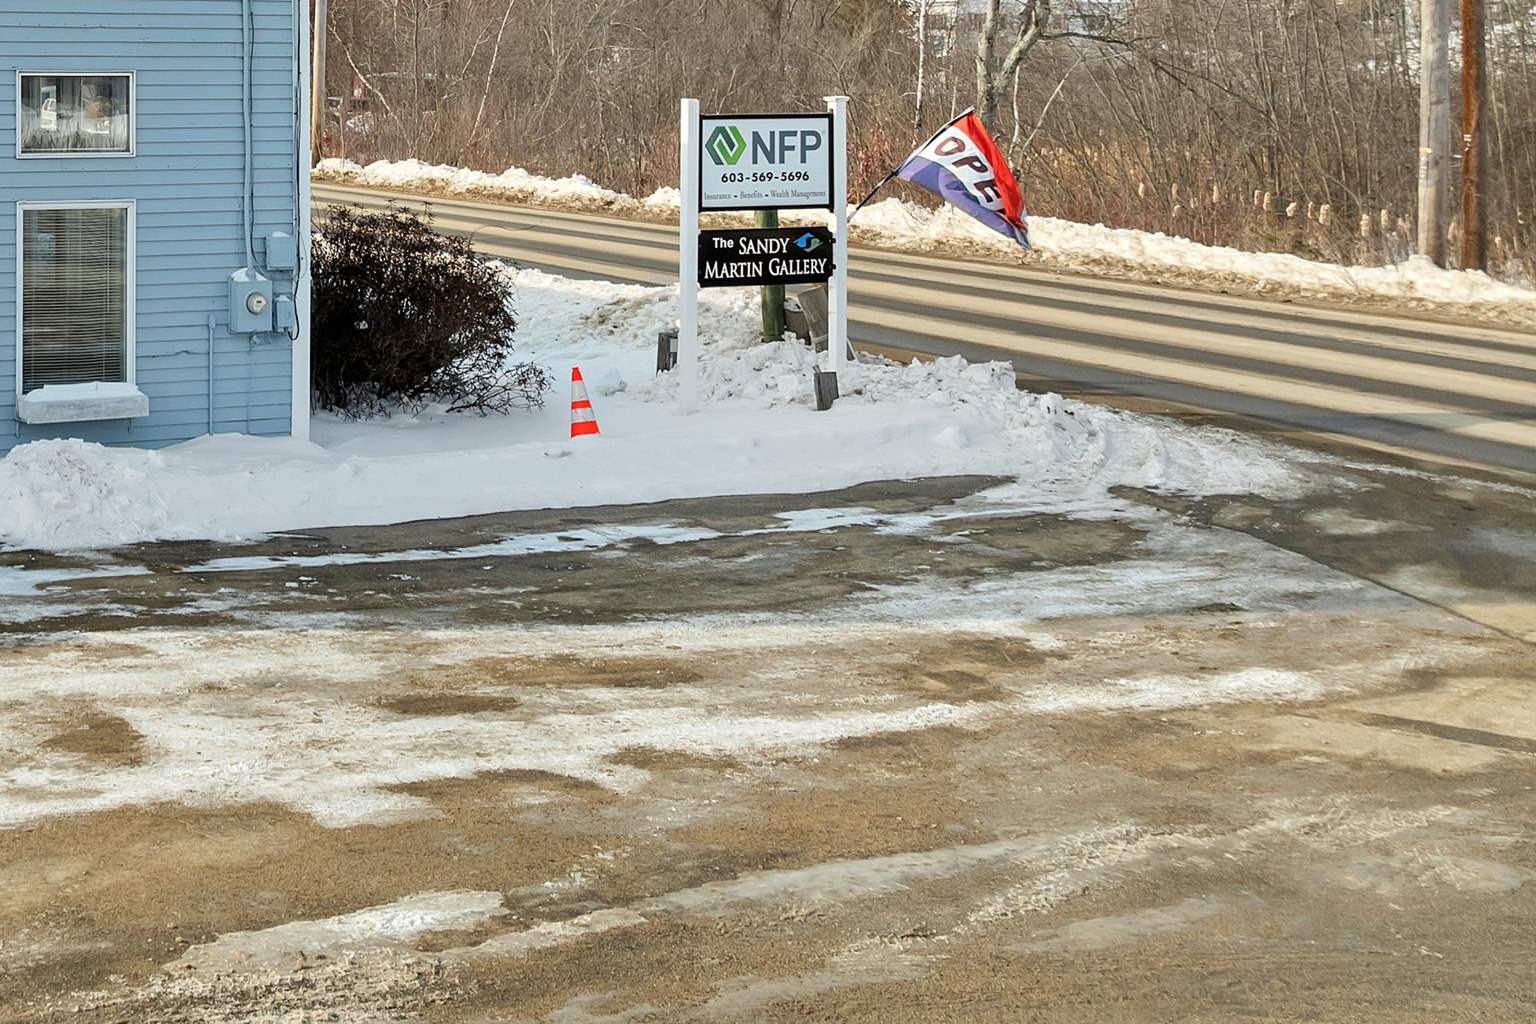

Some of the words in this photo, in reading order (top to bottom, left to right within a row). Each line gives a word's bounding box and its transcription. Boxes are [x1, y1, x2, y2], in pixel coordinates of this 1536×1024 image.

[752, 130, 822, 165] NFP
[721, 171, 810, 184] 603-569-5696
[934, 136, 1006, 215] OPE
[712, 237, 734, 249] The
[738, 237, 790, 255] SANDY
[704, 260, 763, 279] MARTIN
[768, 258, 827, 276] GALLERY
